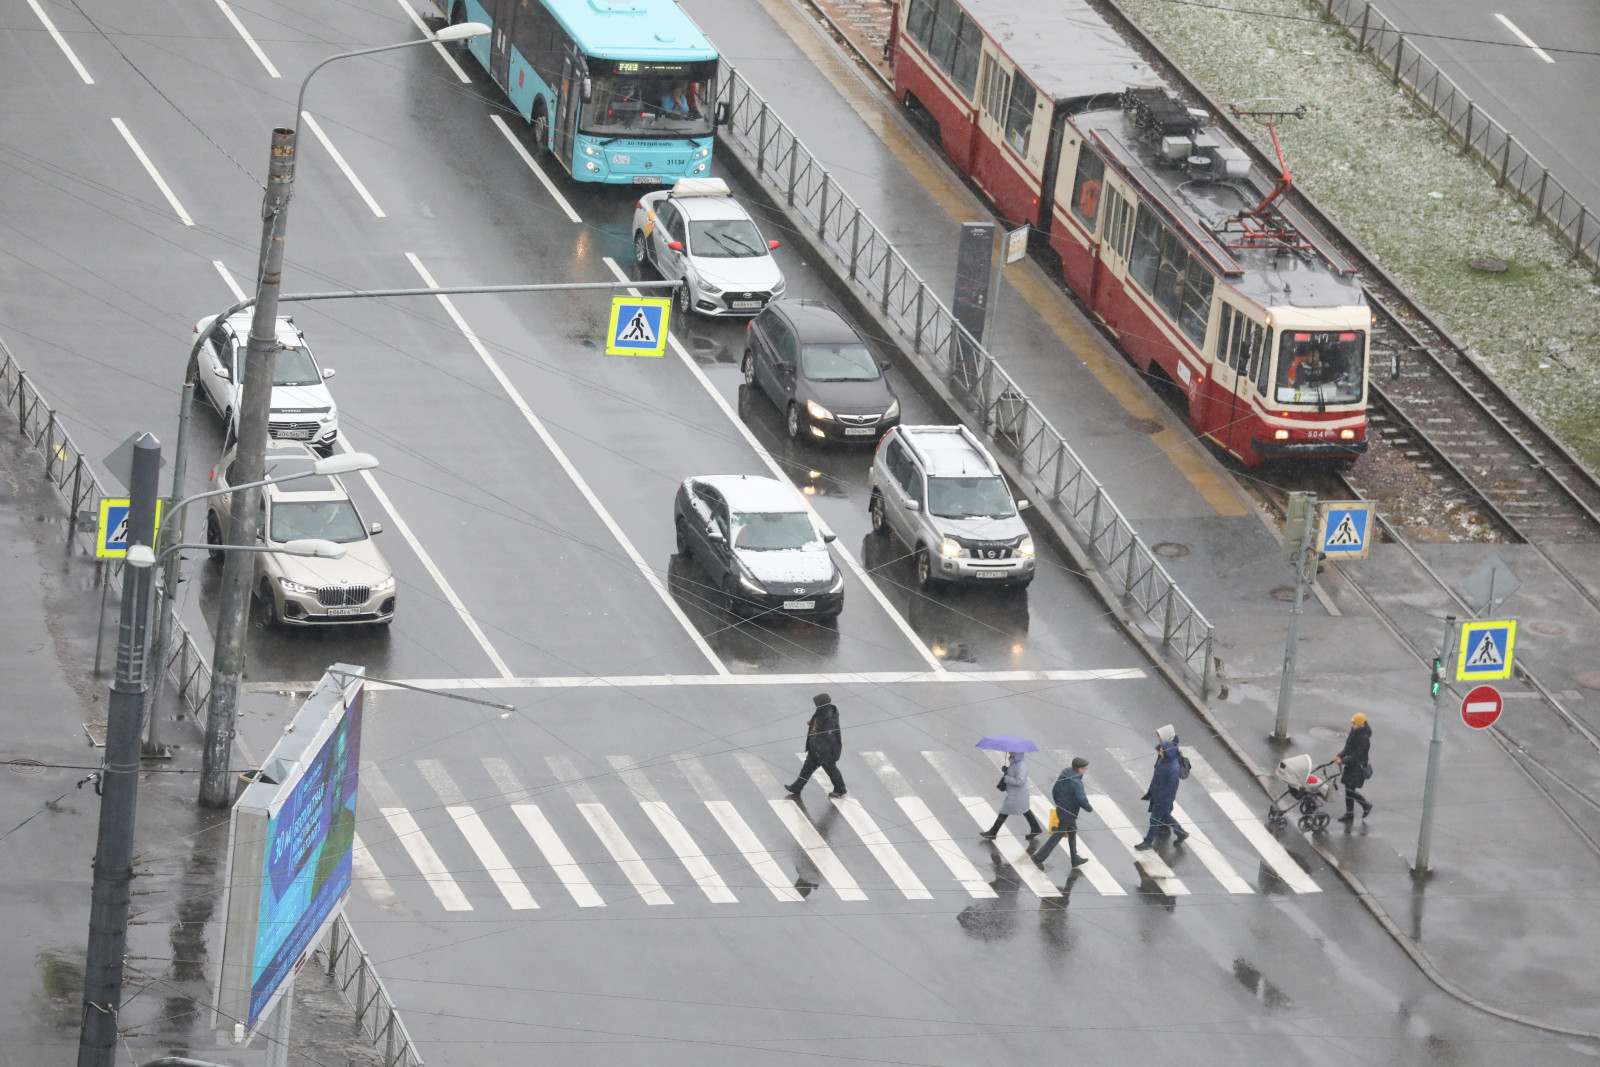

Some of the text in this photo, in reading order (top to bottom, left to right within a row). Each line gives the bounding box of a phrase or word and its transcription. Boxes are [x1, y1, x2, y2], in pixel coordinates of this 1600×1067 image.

[1314, 333, 1329, 344] 47
[1294, 391, 1302, 402] 47
[1307, 430, 1328, 438] 5041
[293, 781, 325, 838] БЕСПЛАТНАЯ
[273, 830, 285, 865] 30
